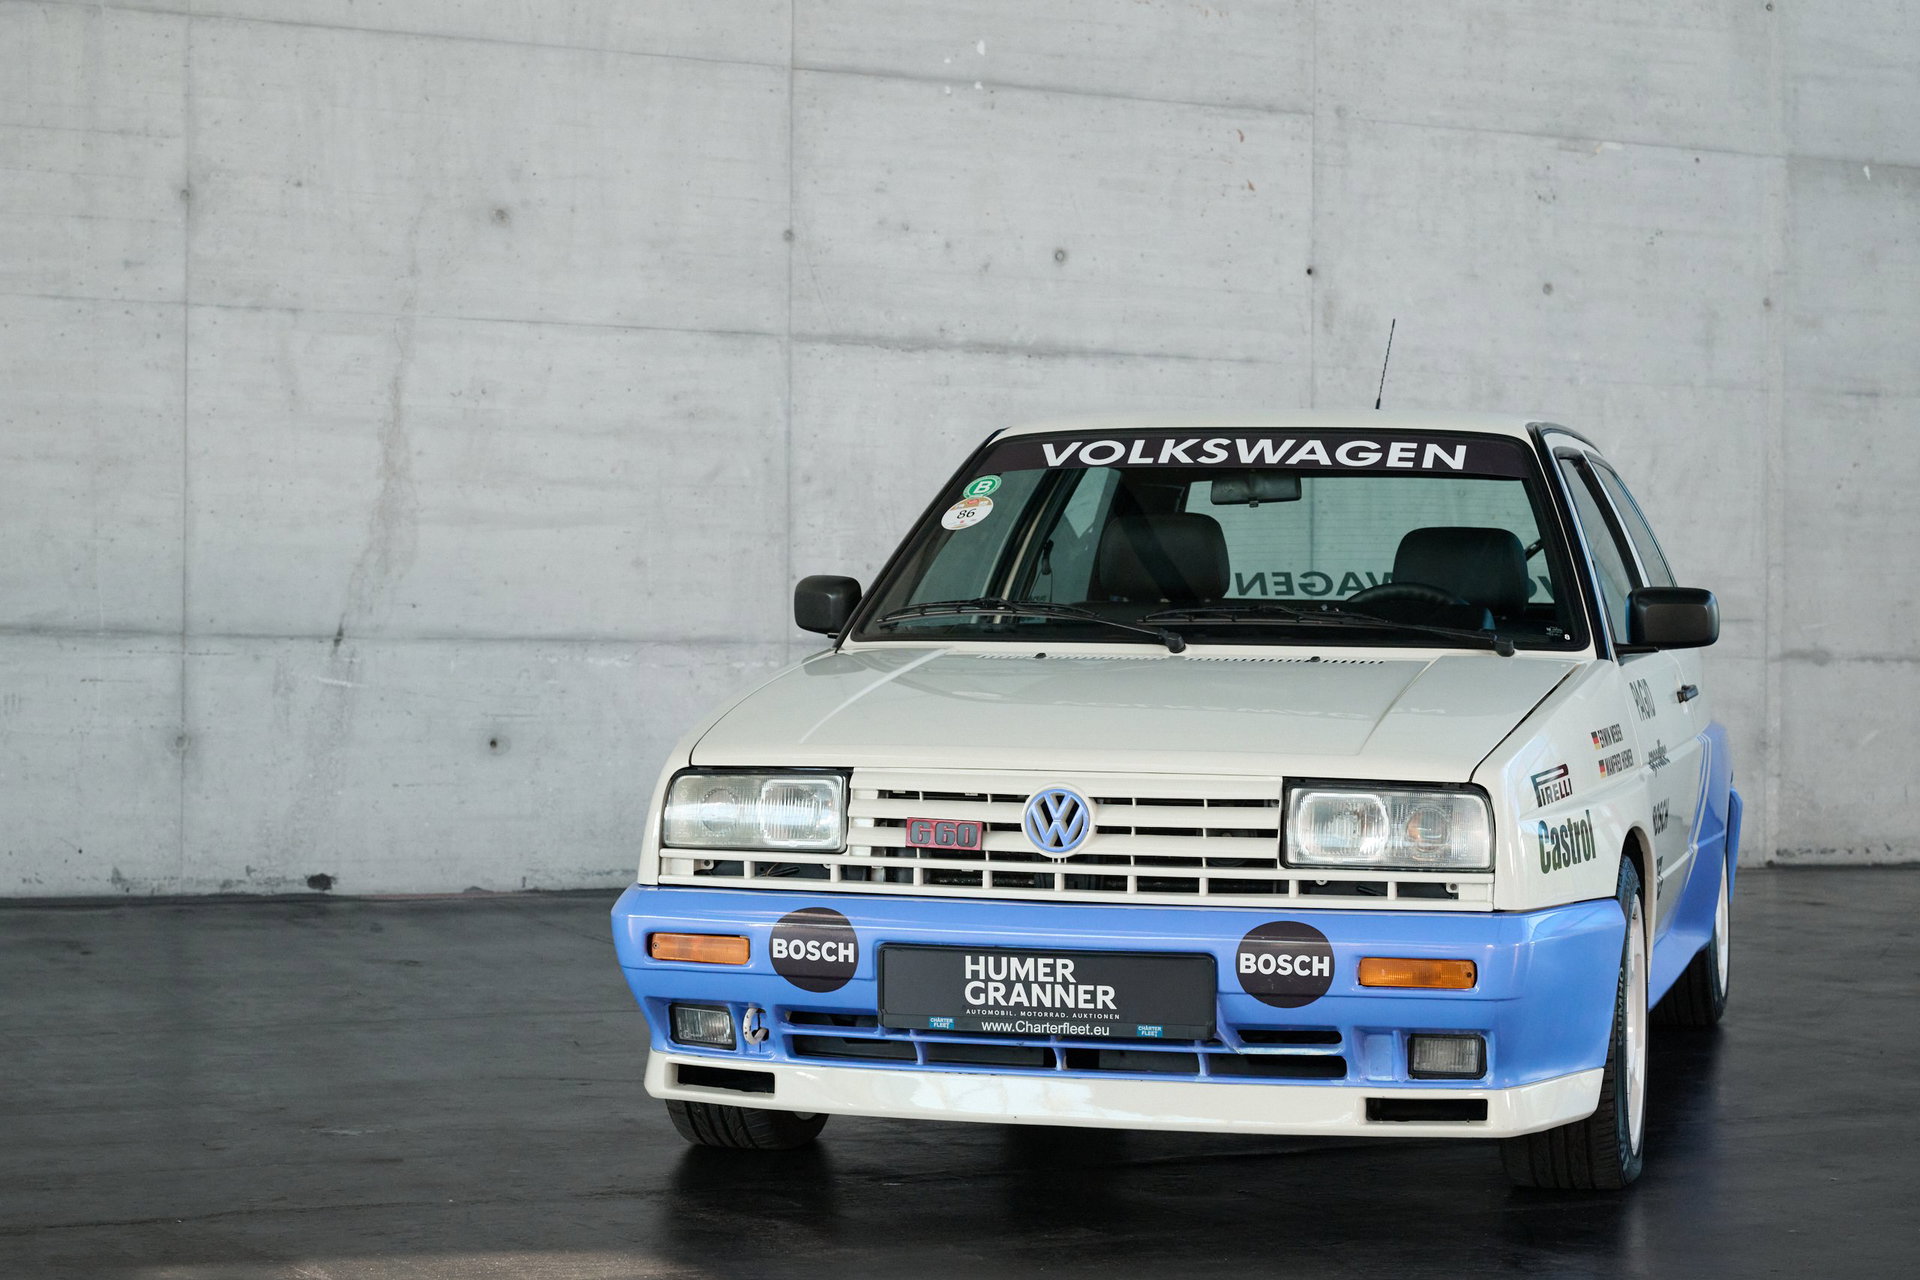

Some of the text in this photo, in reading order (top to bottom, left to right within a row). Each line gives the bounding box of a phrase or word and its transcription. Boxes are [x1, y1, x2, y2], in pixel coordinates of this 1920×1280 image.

[1042, 438, 1467, 470] VOLKSWAGEN
[973, 480, 993, 494] B
[957, 508, 977, 519] 86
[1530, 763, 1573, 808] PIRELLI
[910, 820, 977, 848] G60
[1538, 809, 1596, 874] Castrol
[772, 938, 855, 963] BOSCH
[965, 955, 1076, 983] HUMER
[1240, 953, 1330, 977] BOSCH
[964, 981, 1118, 1010] GRANNER
[966, 1009, 1120, 1020] AUTOMOBIL. MOTORRAD. AUKTIONEN
[981, 1020, 1110, 1037] www.Charterfleet.eu
